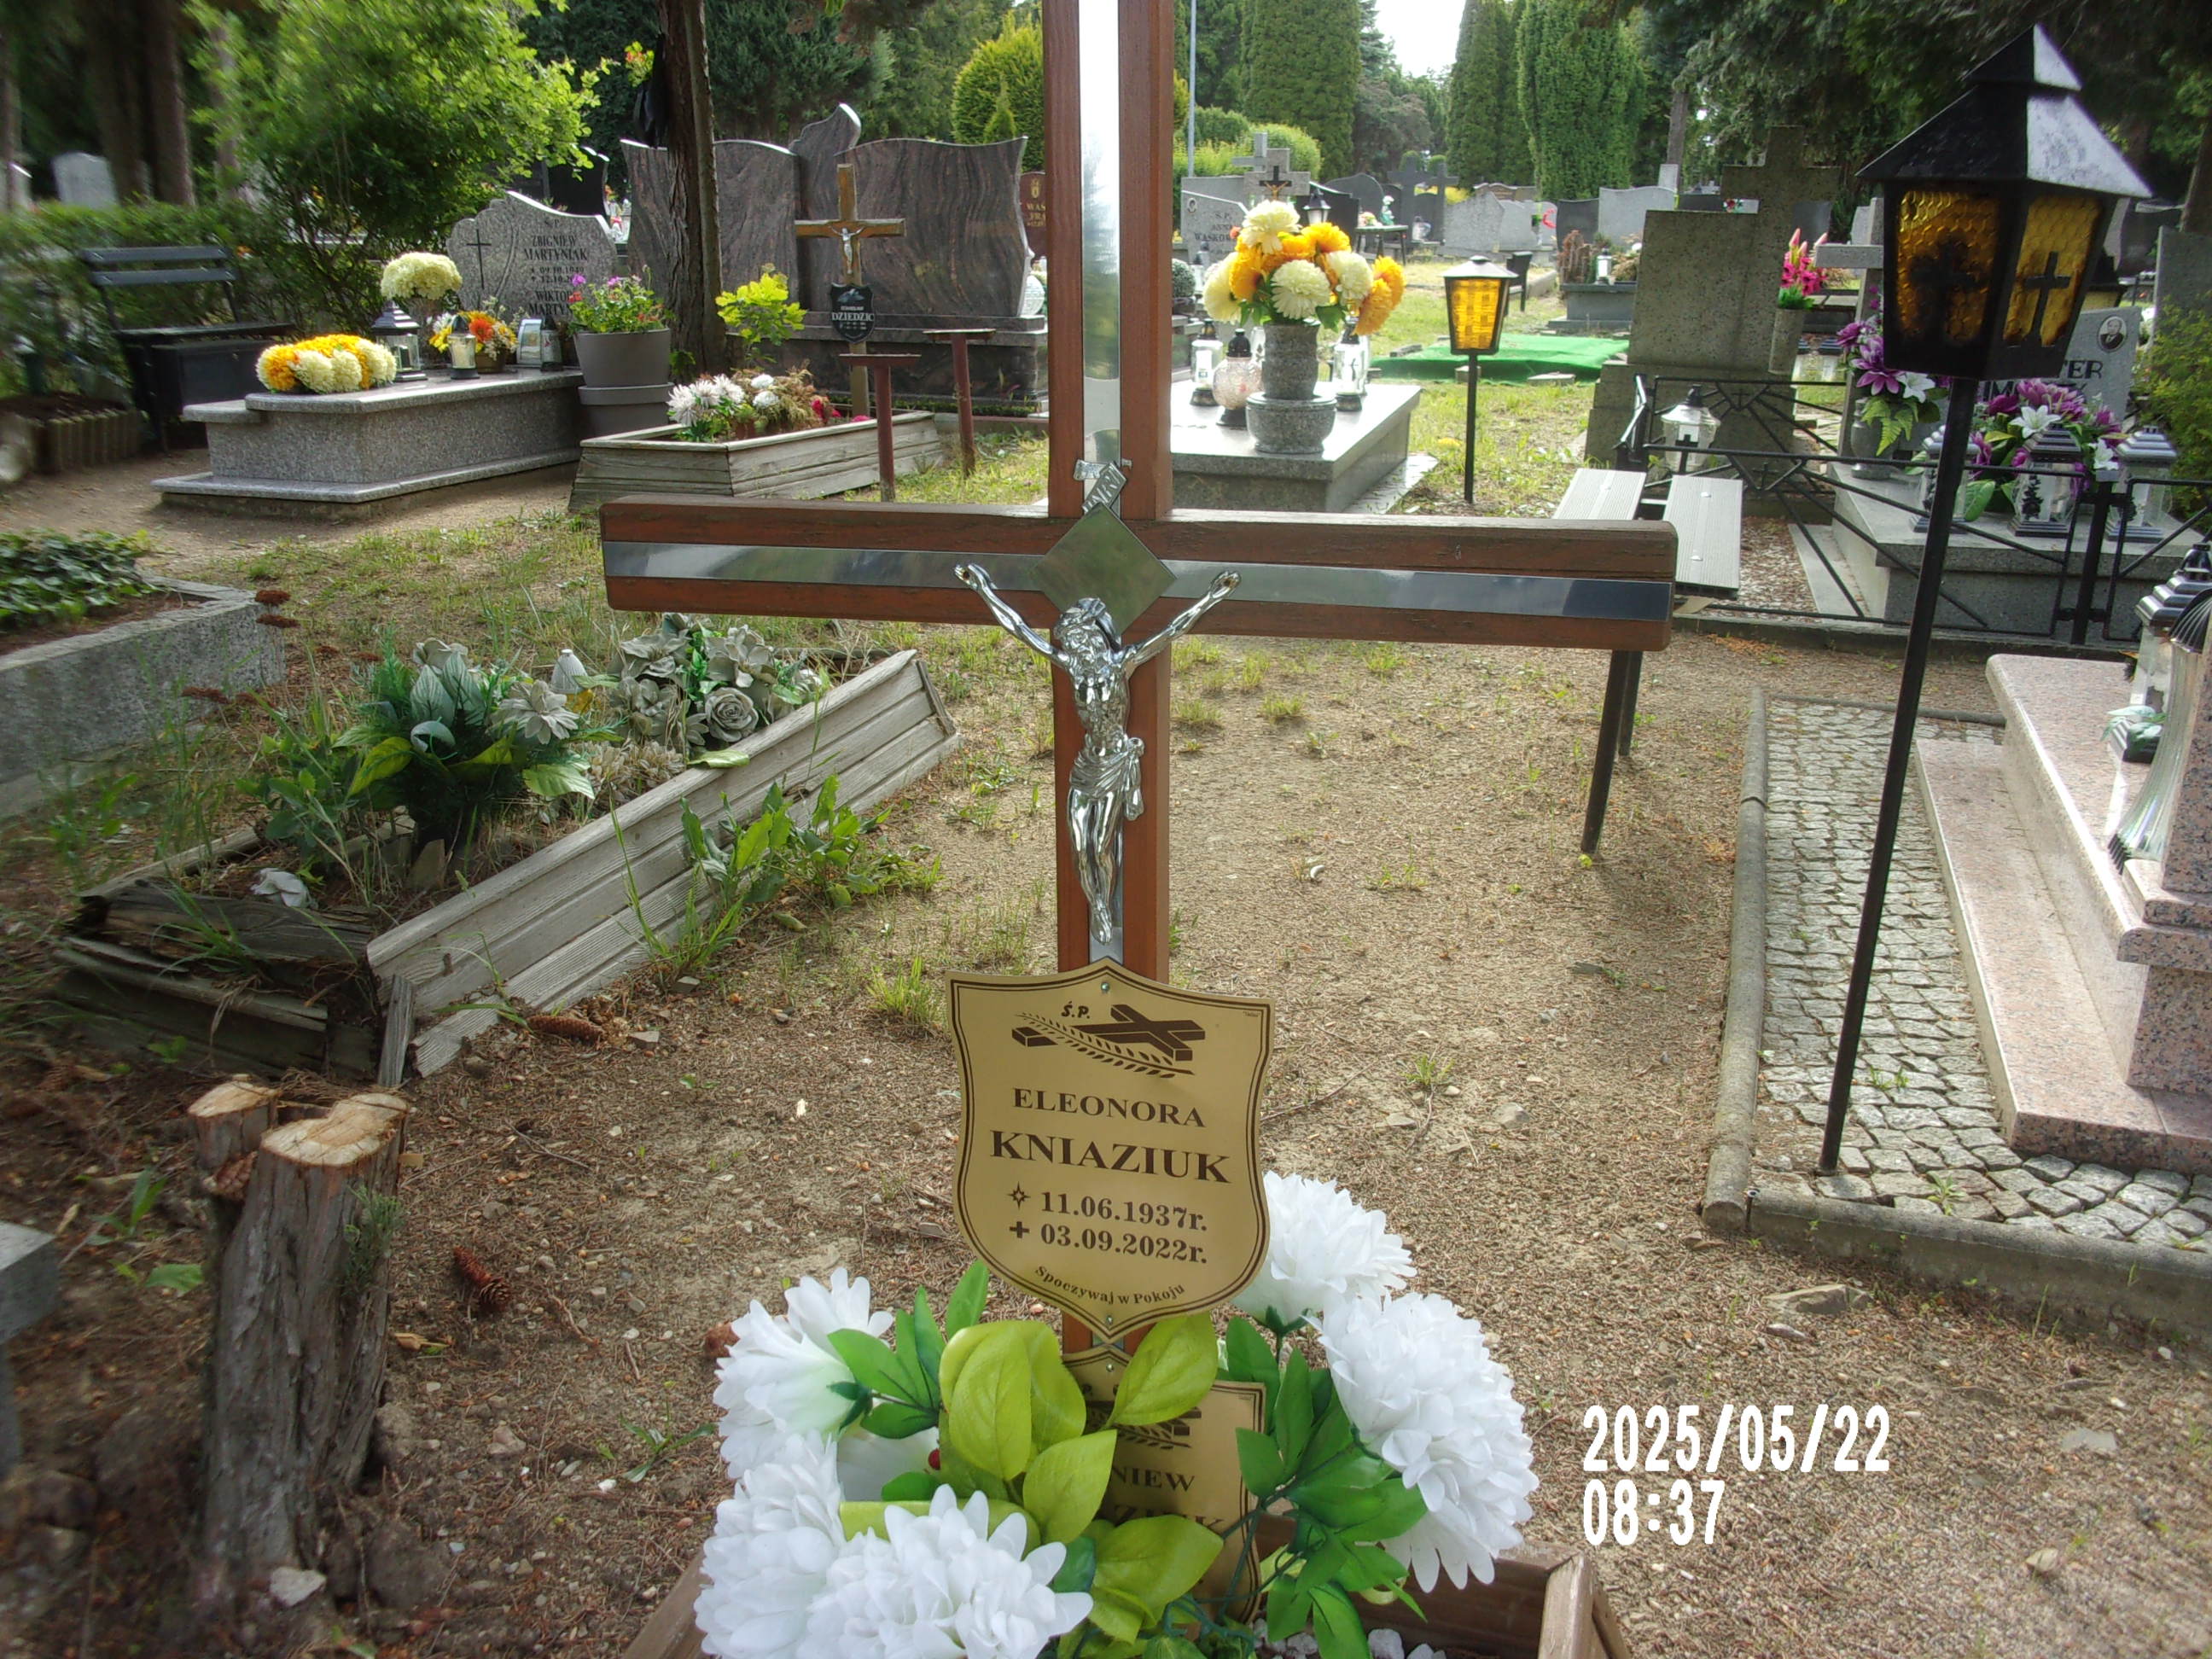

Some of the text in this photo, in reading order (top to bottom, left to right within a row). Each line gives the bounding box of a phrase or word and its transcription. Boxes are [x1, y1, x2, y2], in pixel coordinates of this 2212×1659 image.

[524, 247, 588, 260] MARTYNIAK
[1013, 1087, 1206, 1128] ELEONORA
[990, 1131, 1231, 1184] KNIAZIUK
[1041, 1191, 1208, 1231] 11.06.1937r.
[1041, 1224, 1208, 1264] 03.09.2022r.
[1035, 1266, 1114, 1305] Spoczywaj
[1133, 1284, 1185, 1304] Pokoju
